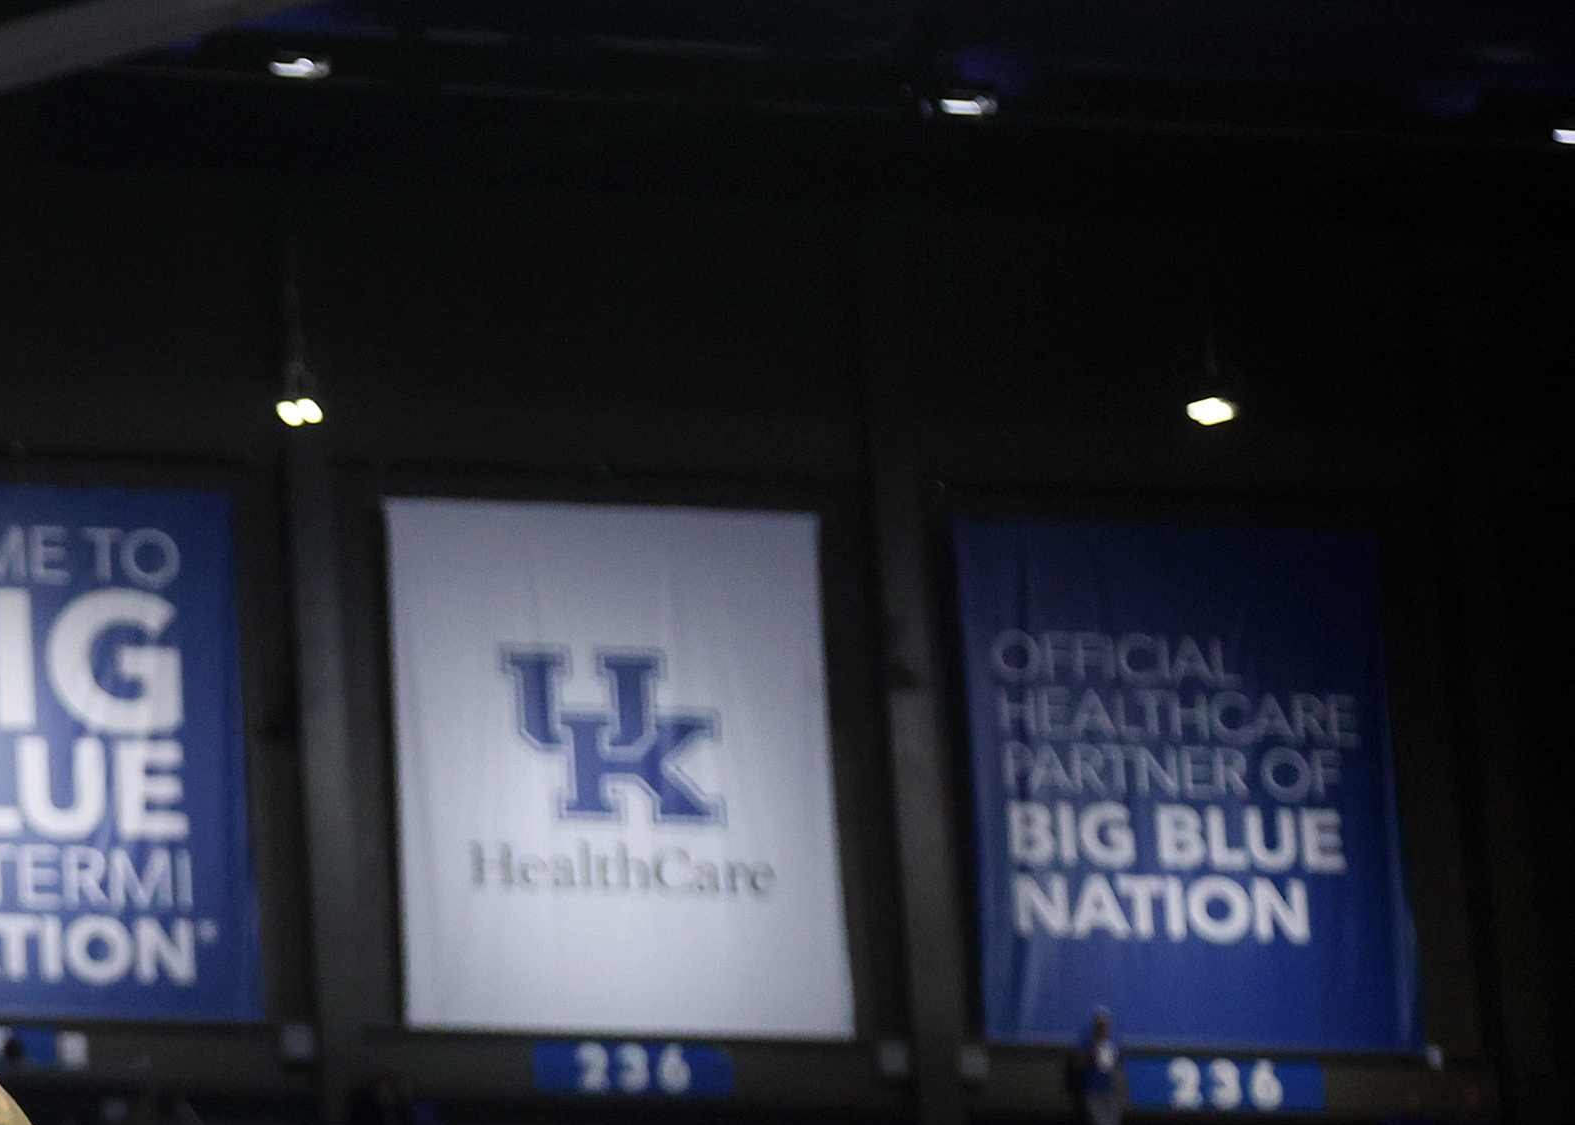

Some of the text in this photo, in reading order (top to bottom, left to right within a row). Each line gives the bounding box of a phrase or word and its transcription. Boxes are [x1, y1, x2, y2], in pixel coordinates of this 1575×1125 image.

[81, 526, 180, 590] TO
[991, 627, 1240, 690] OFFICIAL
[498, 641, 726, 824] UK
[998, 687, 1360, 748] HEALTHCARE
[1003, 741, 1342, 803] PARTNER OF
[469, 840, 777, 896] HealthCare
[1007, 801, 1347, 874] BIG BLUE
[1010, 873, 1311, 946] NATION
[1167, 1056, 1283, 1112] 236
